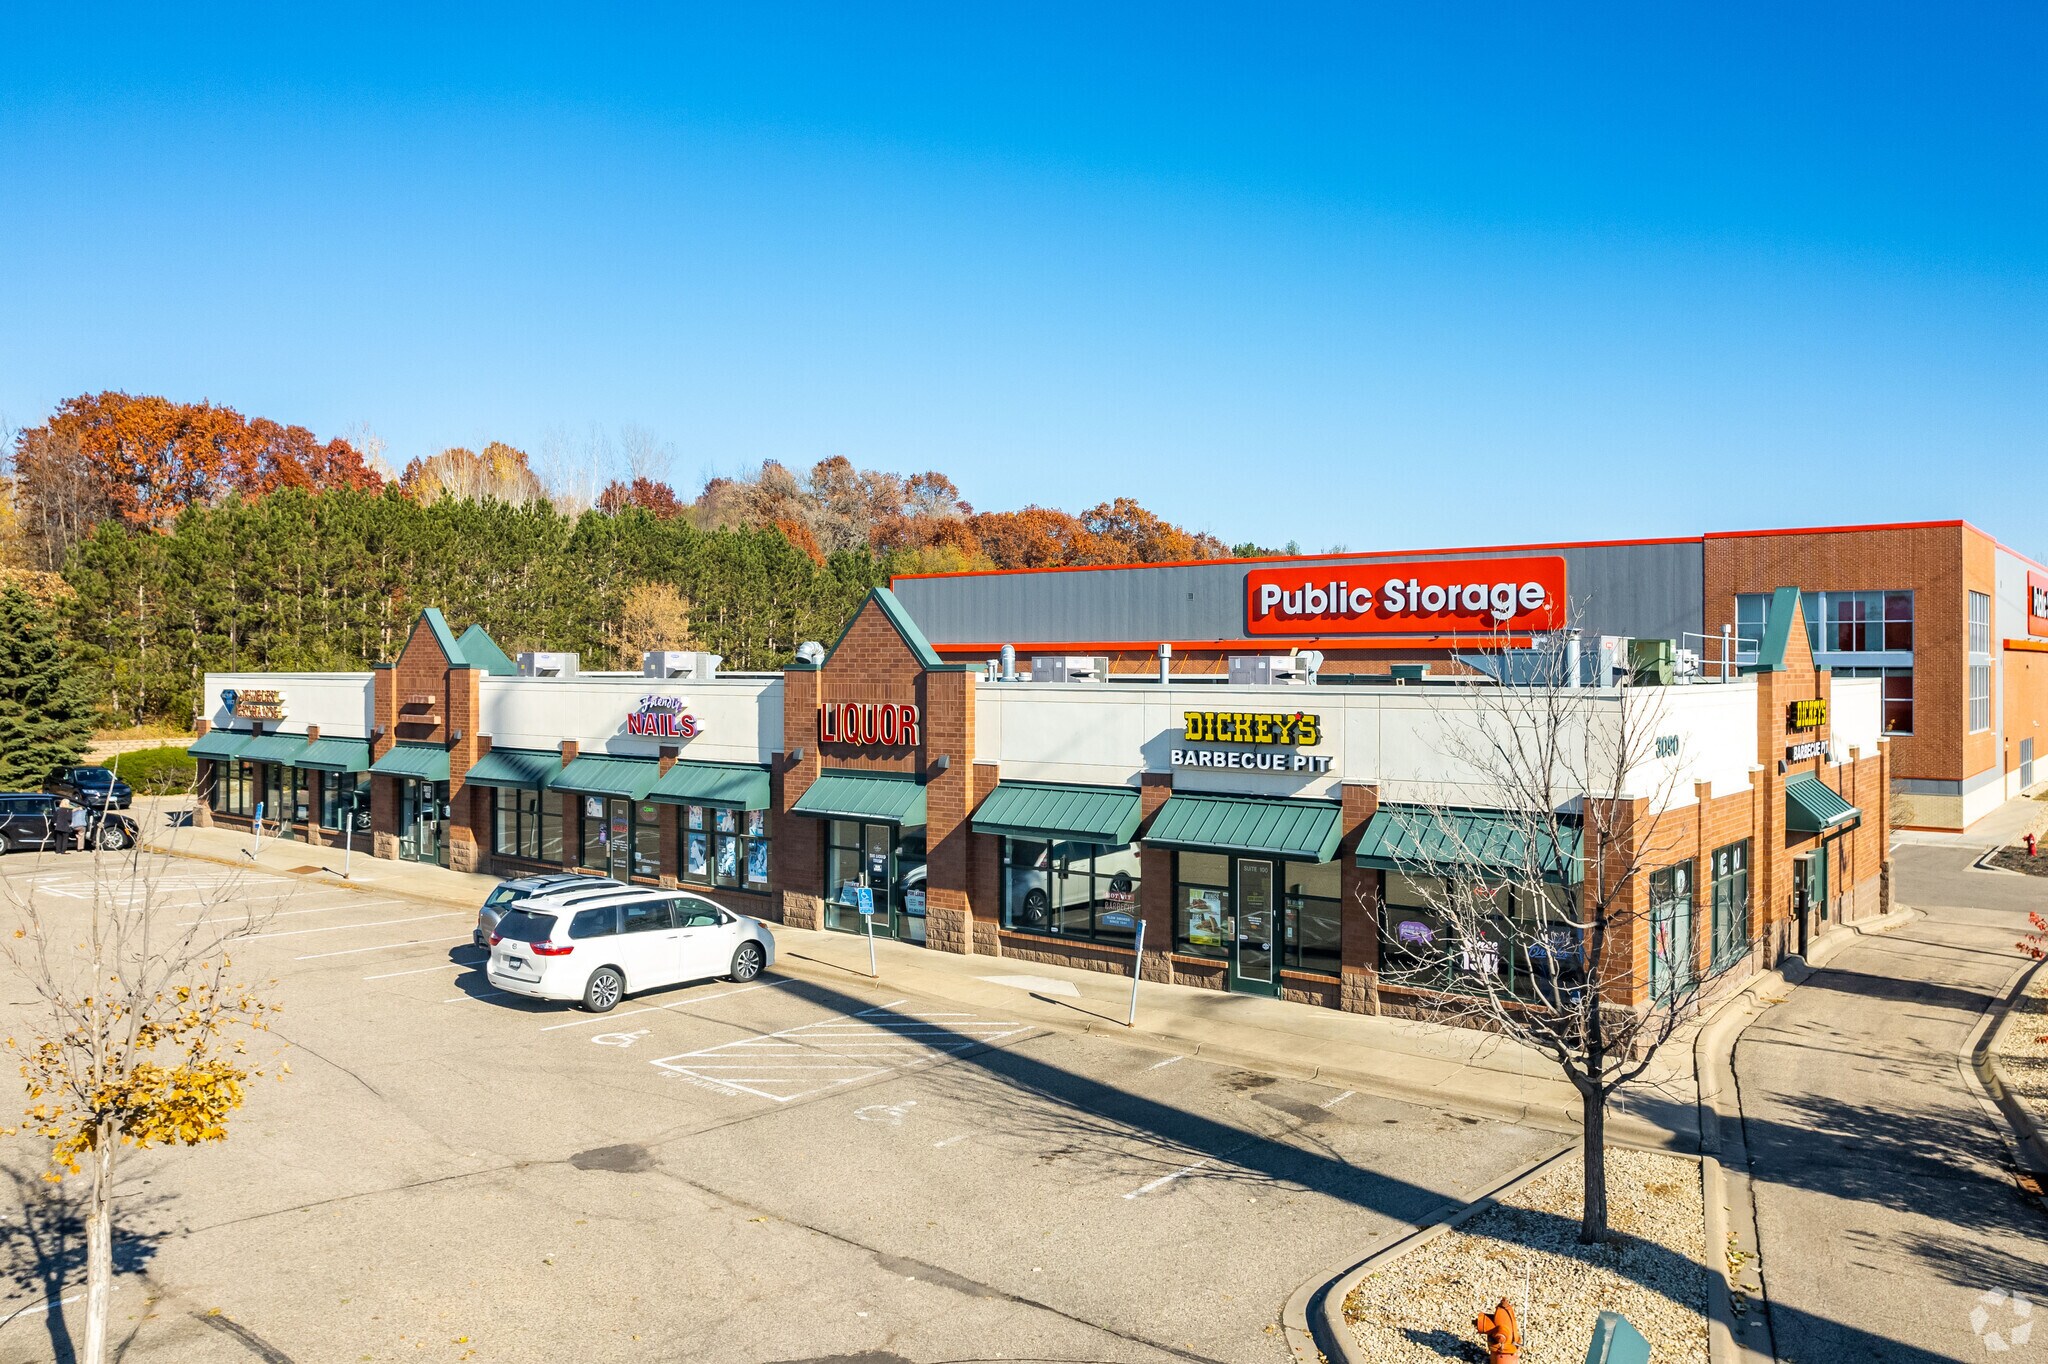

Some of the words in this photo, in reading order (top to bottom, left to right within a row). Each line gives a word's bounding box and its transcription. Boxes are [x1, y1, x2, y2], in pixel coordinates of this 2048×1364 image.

[1260, 580, 1373, 615] Public
[1383, 578, 1546, 620] Storage
[640, 694, 682, 713] Friendly
[626, 713, 696, 738] NAILS
[820, 702, 920, 747] LIQUOR
[1184, 711, 1320, 746] DICKEY'S
[1655, 734, 1679, 759] 3090
[1793, 743, 1821, 762] BARBECUE
[1171, 749, 1287, 771] BARBECUE
[1293, 755, 1332, 773] PIT
[1243, 865, 1257, 873] SUITE
[1259, 866, 1269, 874] 100
[1104, 901, 1135, 912] BARBECUE
